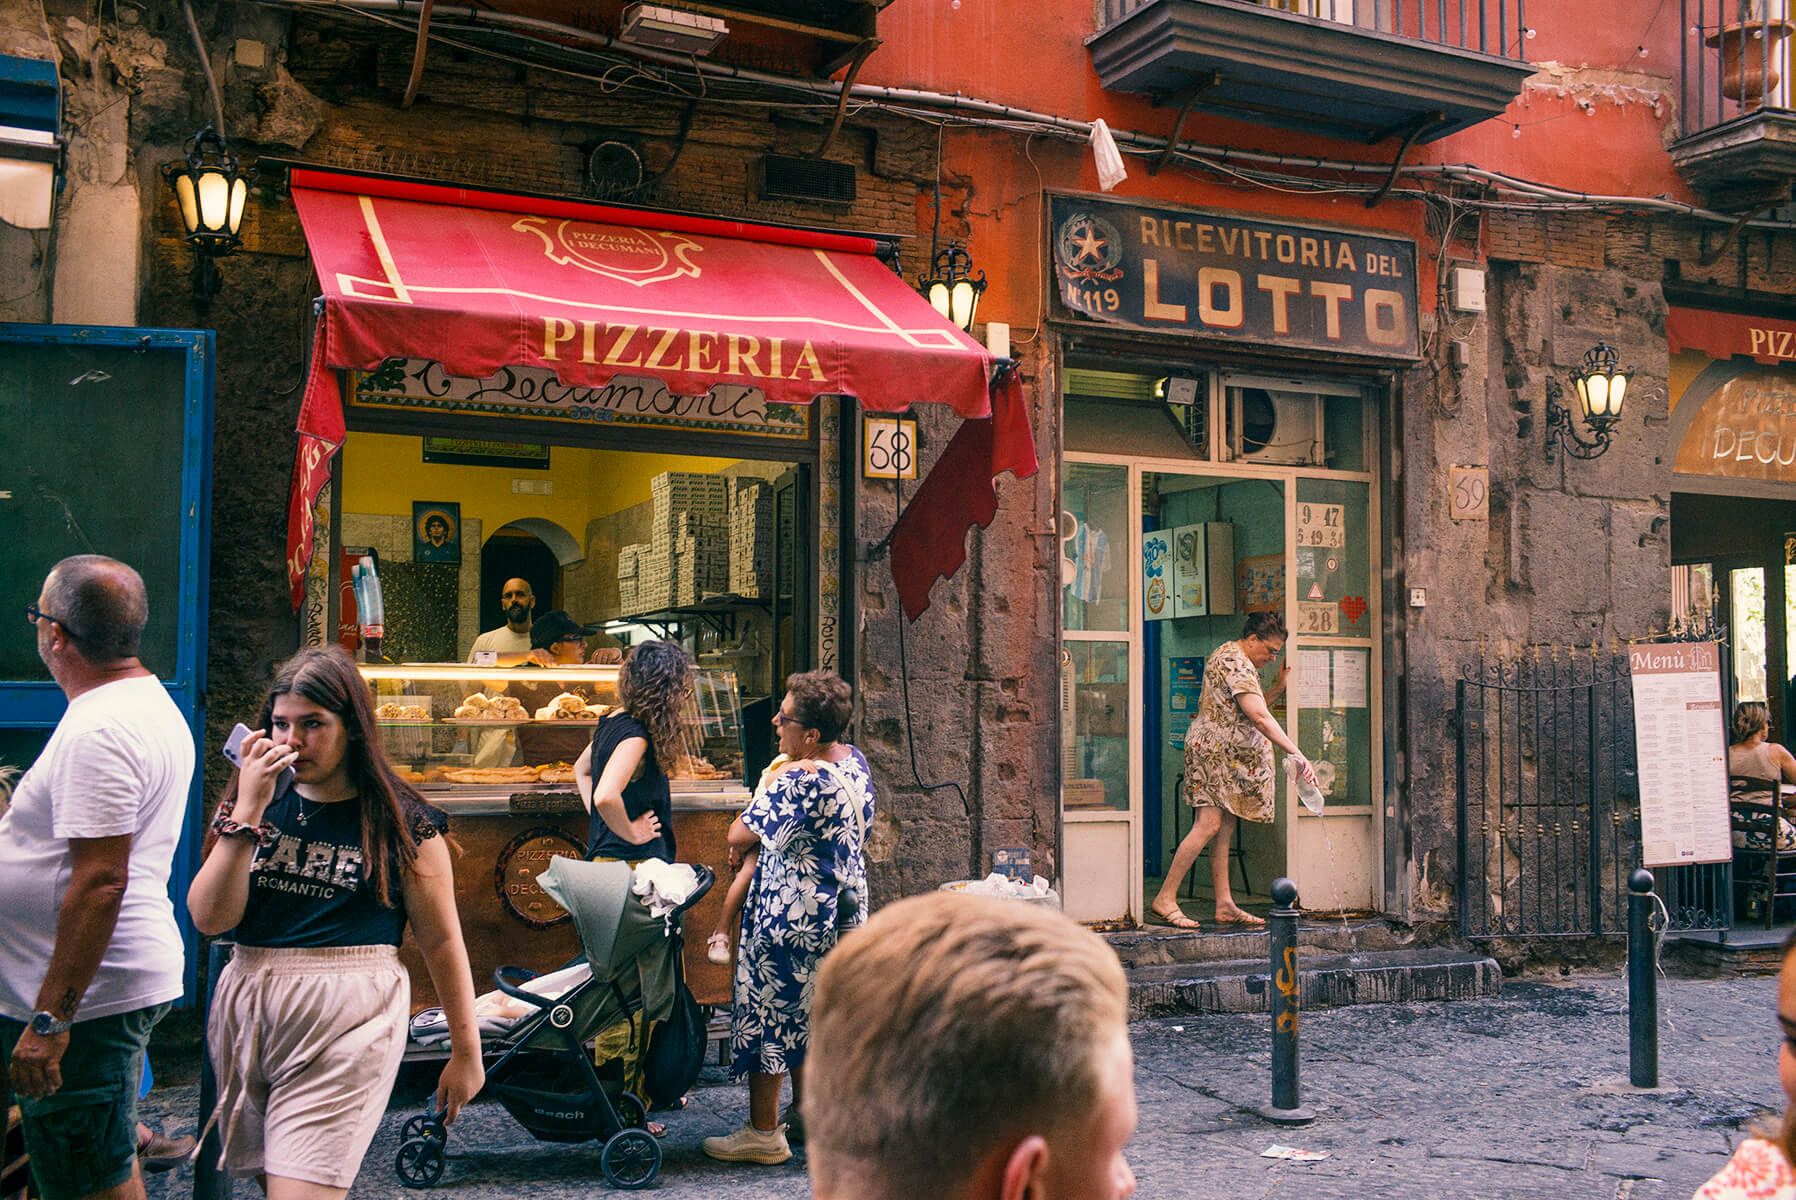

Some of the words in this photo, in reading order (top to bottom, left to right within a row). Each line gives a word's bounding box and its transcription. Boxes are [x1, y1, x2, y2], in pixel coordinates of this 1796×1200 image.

[572, 231, 647, 246] PIZZERIA
[578, 241, 662, 256] DECUMANI
[1139, 216, 1356, 271] RICEVITORIA
[1366, 252, 1402, 278] DEL
[1083, 288, 1121, 313] 119
[1142, 259, 1408, 347] LOTTO
[541, 317, 828, 383] PIZZERIA
[1749, 328, 1796, 359] PIZ
[1302, 504, 1312, 524] 9
[1631, 651, 1685, 670] Menù
[257, 875, 335, 899] ROMANTIC
